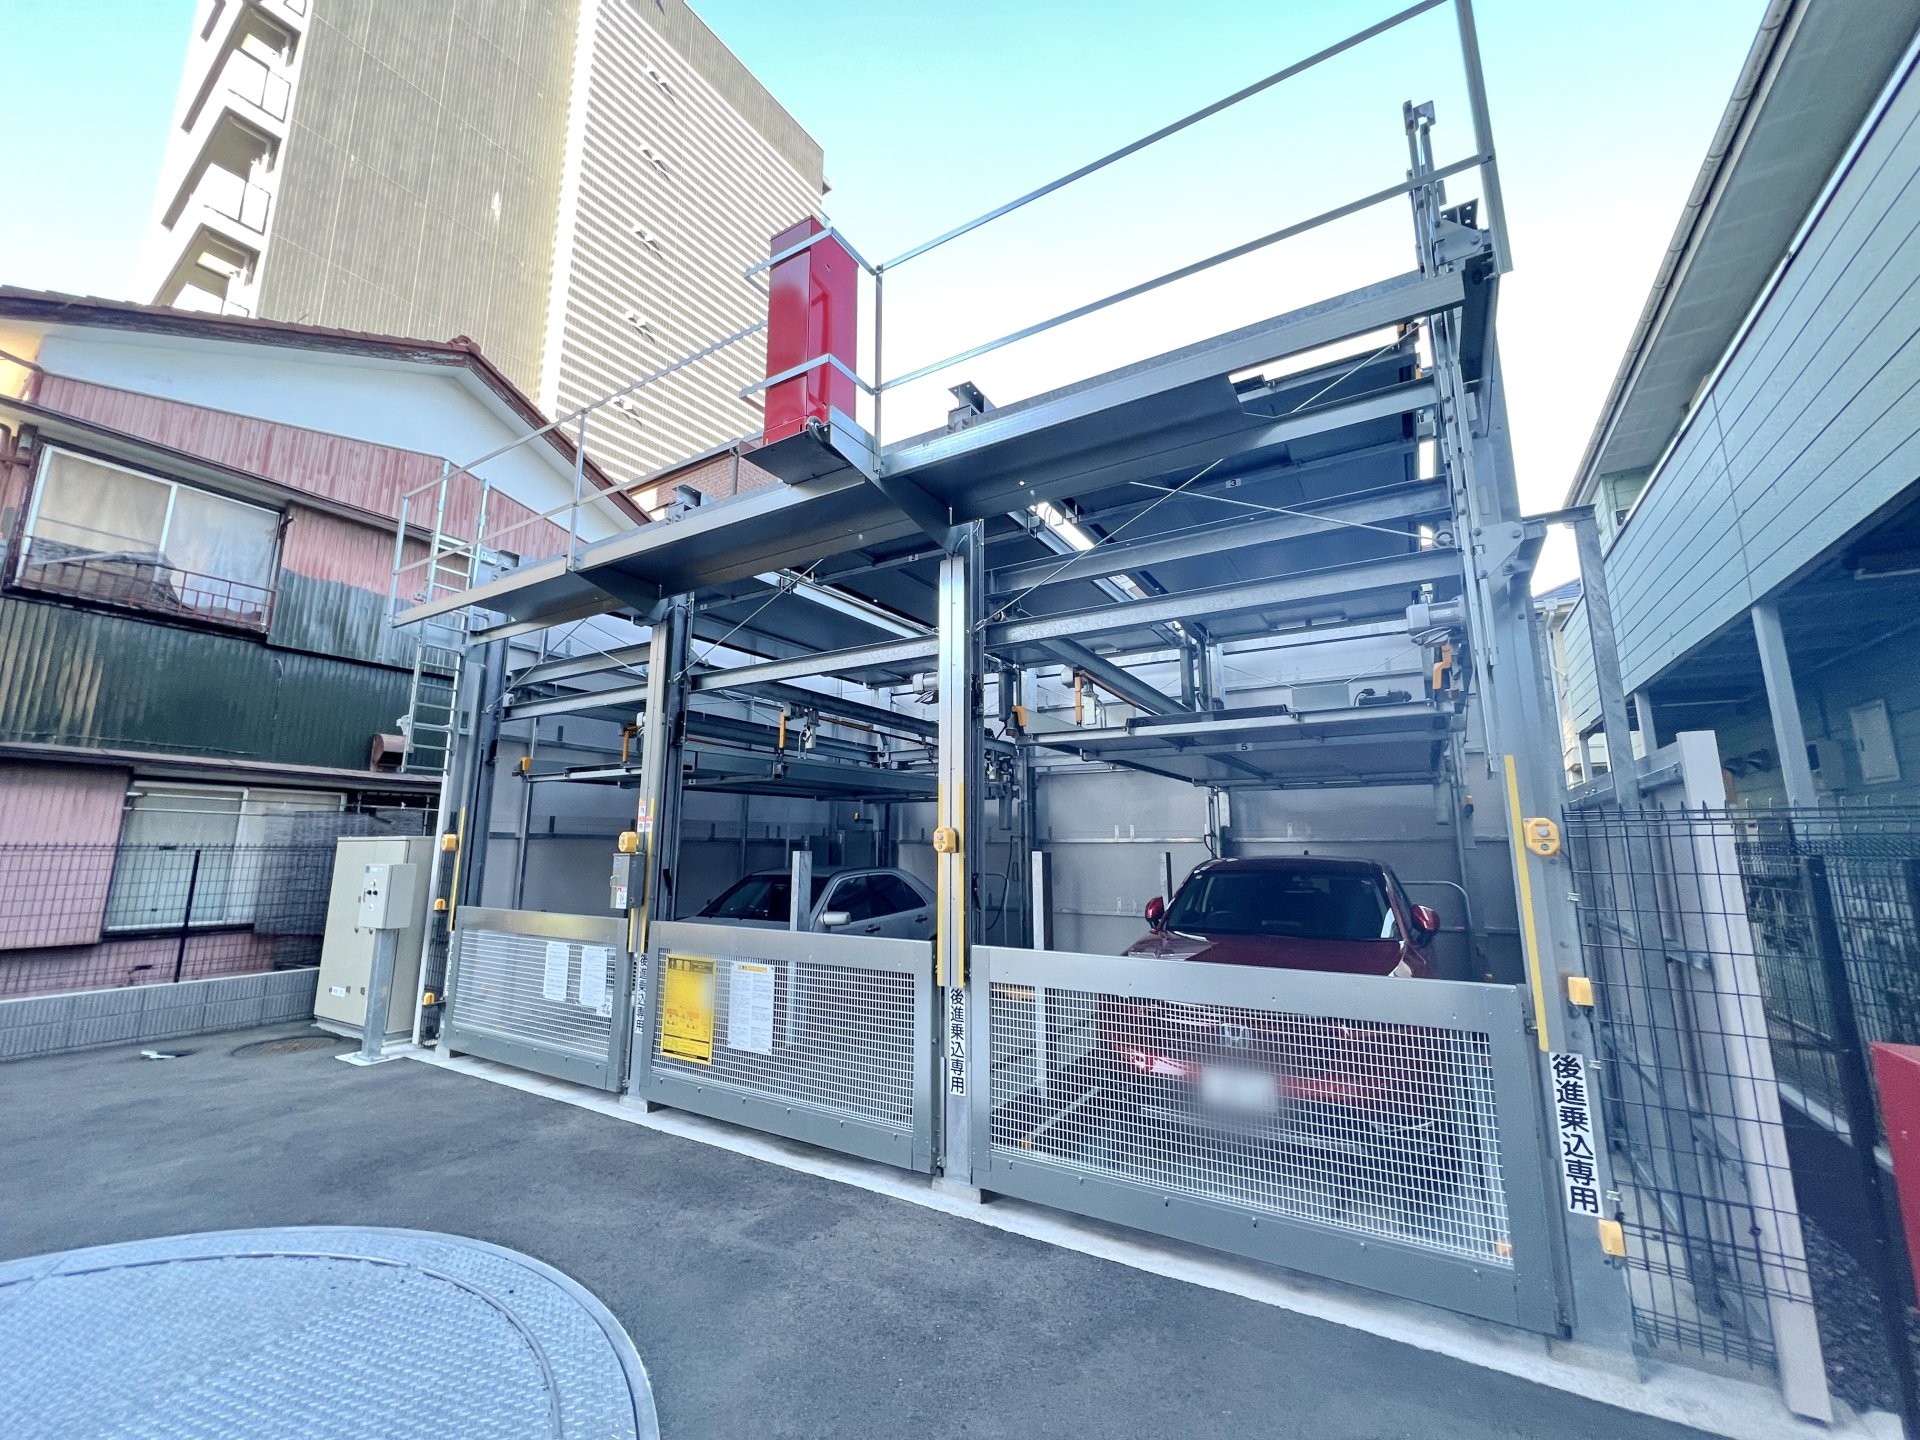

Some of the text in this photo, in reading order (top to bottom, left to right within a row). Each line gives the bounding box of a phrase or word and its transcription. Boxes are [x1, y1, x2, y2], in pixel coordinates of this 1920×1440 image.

[1230, 479, 1237, 487] 3
[950, 987, 965, 1095] 後進乗込専用
[1552, 1053, 1599, 1214] 後進乗込専用
